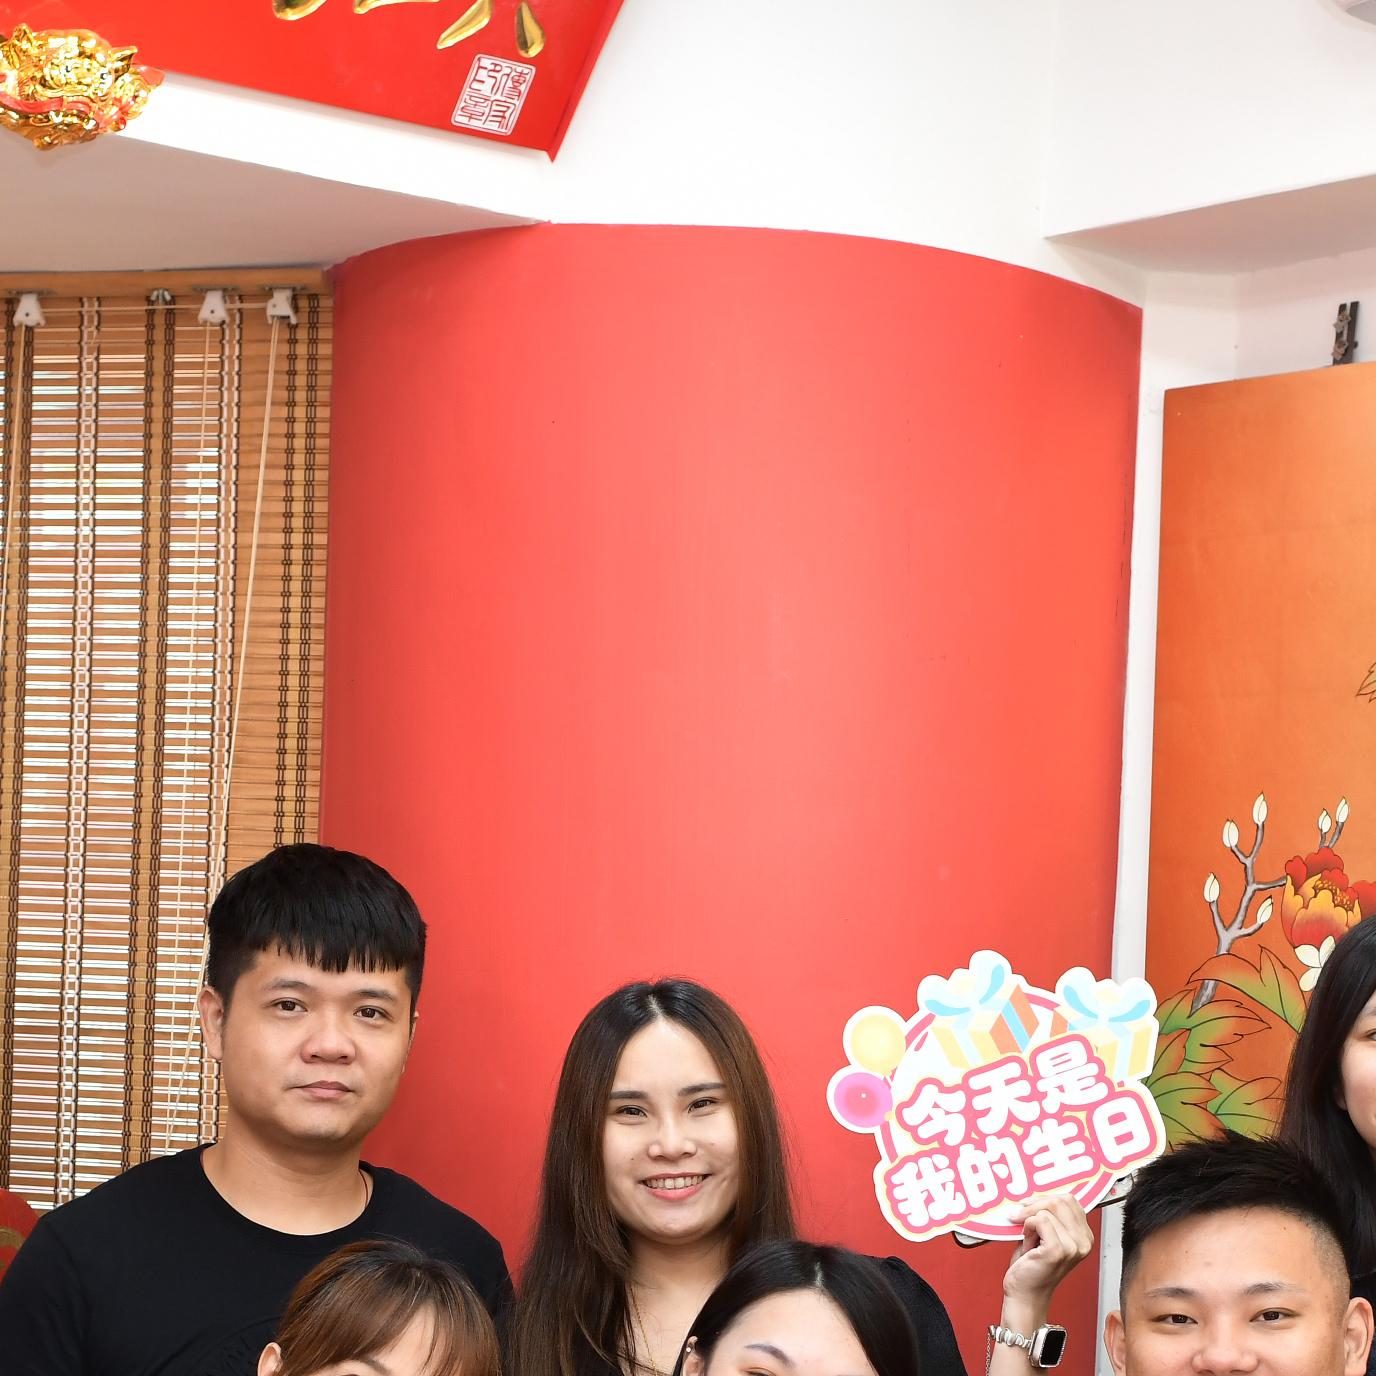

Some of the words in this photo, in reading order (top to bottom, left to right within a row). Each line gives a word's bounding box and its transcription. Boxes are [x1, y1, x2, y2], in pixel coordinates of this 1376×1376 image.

[901, 1039, 1109, 1147] 今天是
[890, 1096, 1152, 1228] 我的生日
